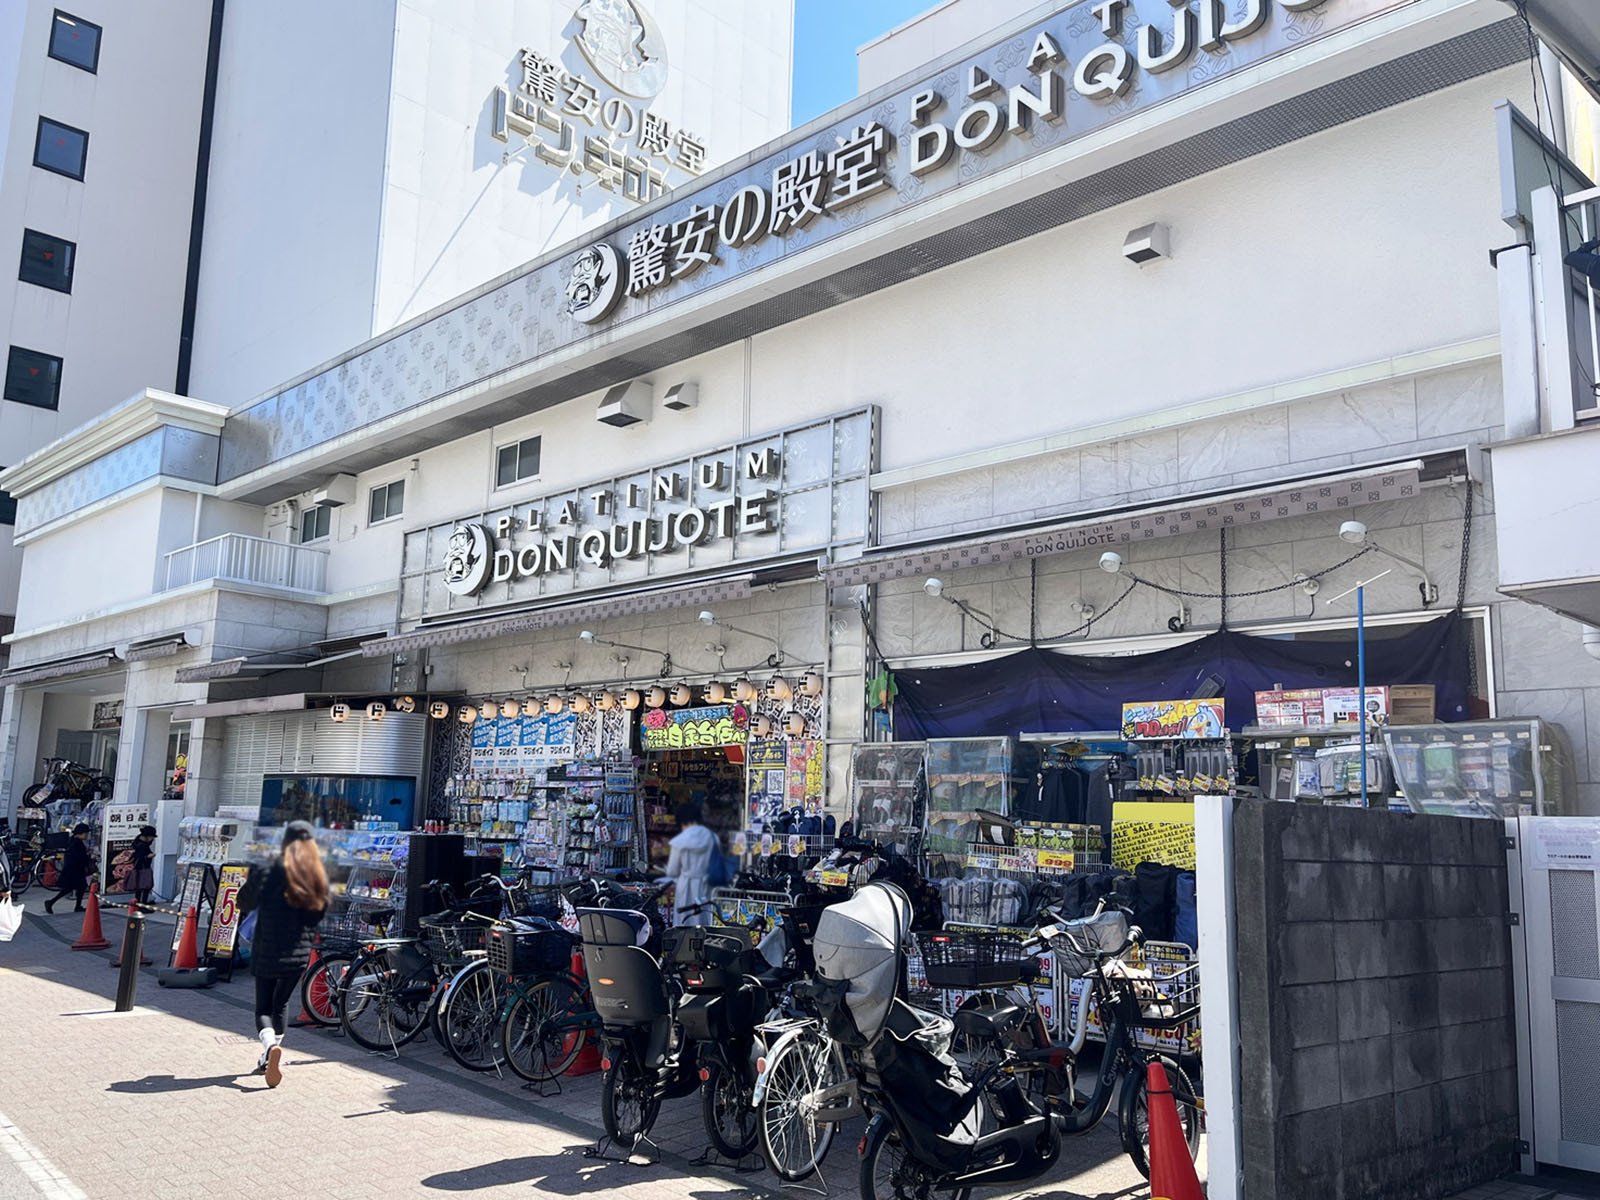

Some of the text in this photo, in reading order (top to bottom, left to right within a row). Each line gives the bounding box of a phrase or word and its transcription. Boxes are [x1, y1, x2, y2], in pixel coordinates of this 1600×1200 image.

[519, 47, 705, 177] 驚安の殿堂
[911, 0, 1300, 176] DON QUIJ
[624, 121, 888, 299] 驚安の殿堂
[494, 488, 777, 583] DON QUIJOTE
[497, 447, 780, 539] PLATINUM
[1025, 525, 1114, 545] PLATINUM
[1026, 533, 1116, 556] DON QUIJOTE
[1132, 823, 1154, 834] SALE
[1167, 845, 1190, 857] SALE
